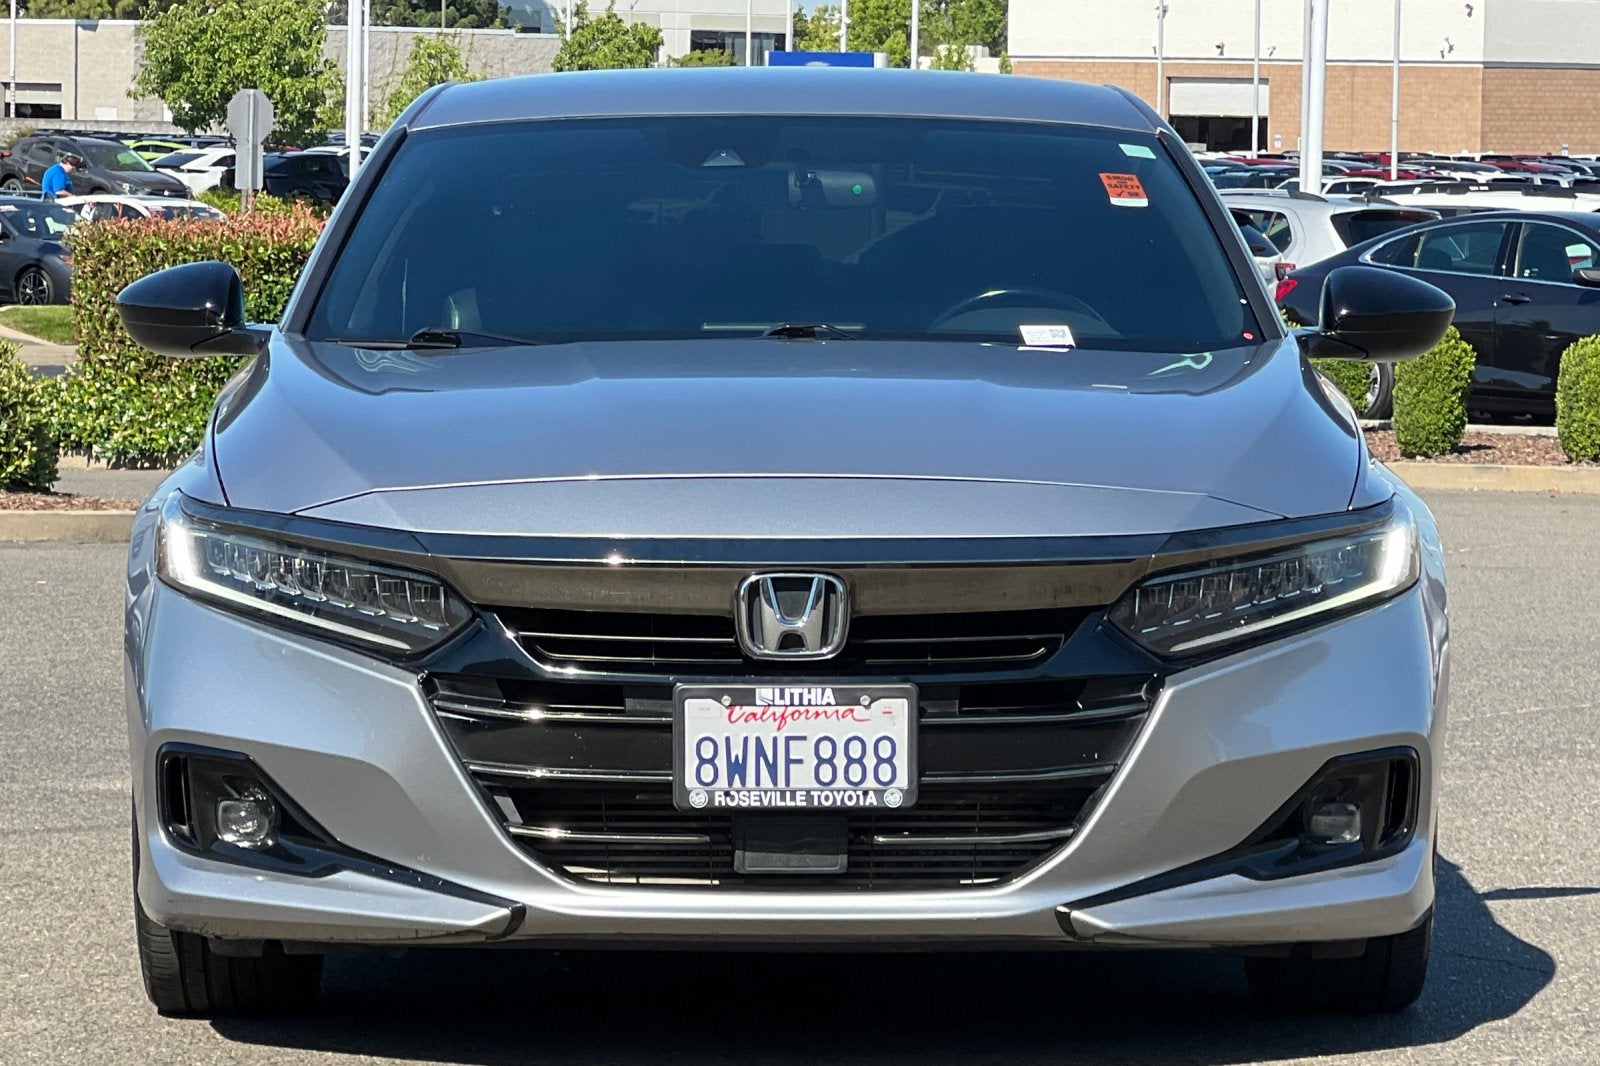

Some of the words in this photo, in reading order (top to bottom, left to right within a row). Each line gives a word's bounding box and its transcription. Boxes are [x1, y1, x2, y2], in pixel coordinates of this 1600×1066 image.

[773, 688, 836, 706] LITHIA
[727, 705, 871, 732] California
[695, 735, 897, 787] 8WNF888
[714, 790, 807, 806] ROSEVILLE
[810, 790, 878, 806] TOYOTA
